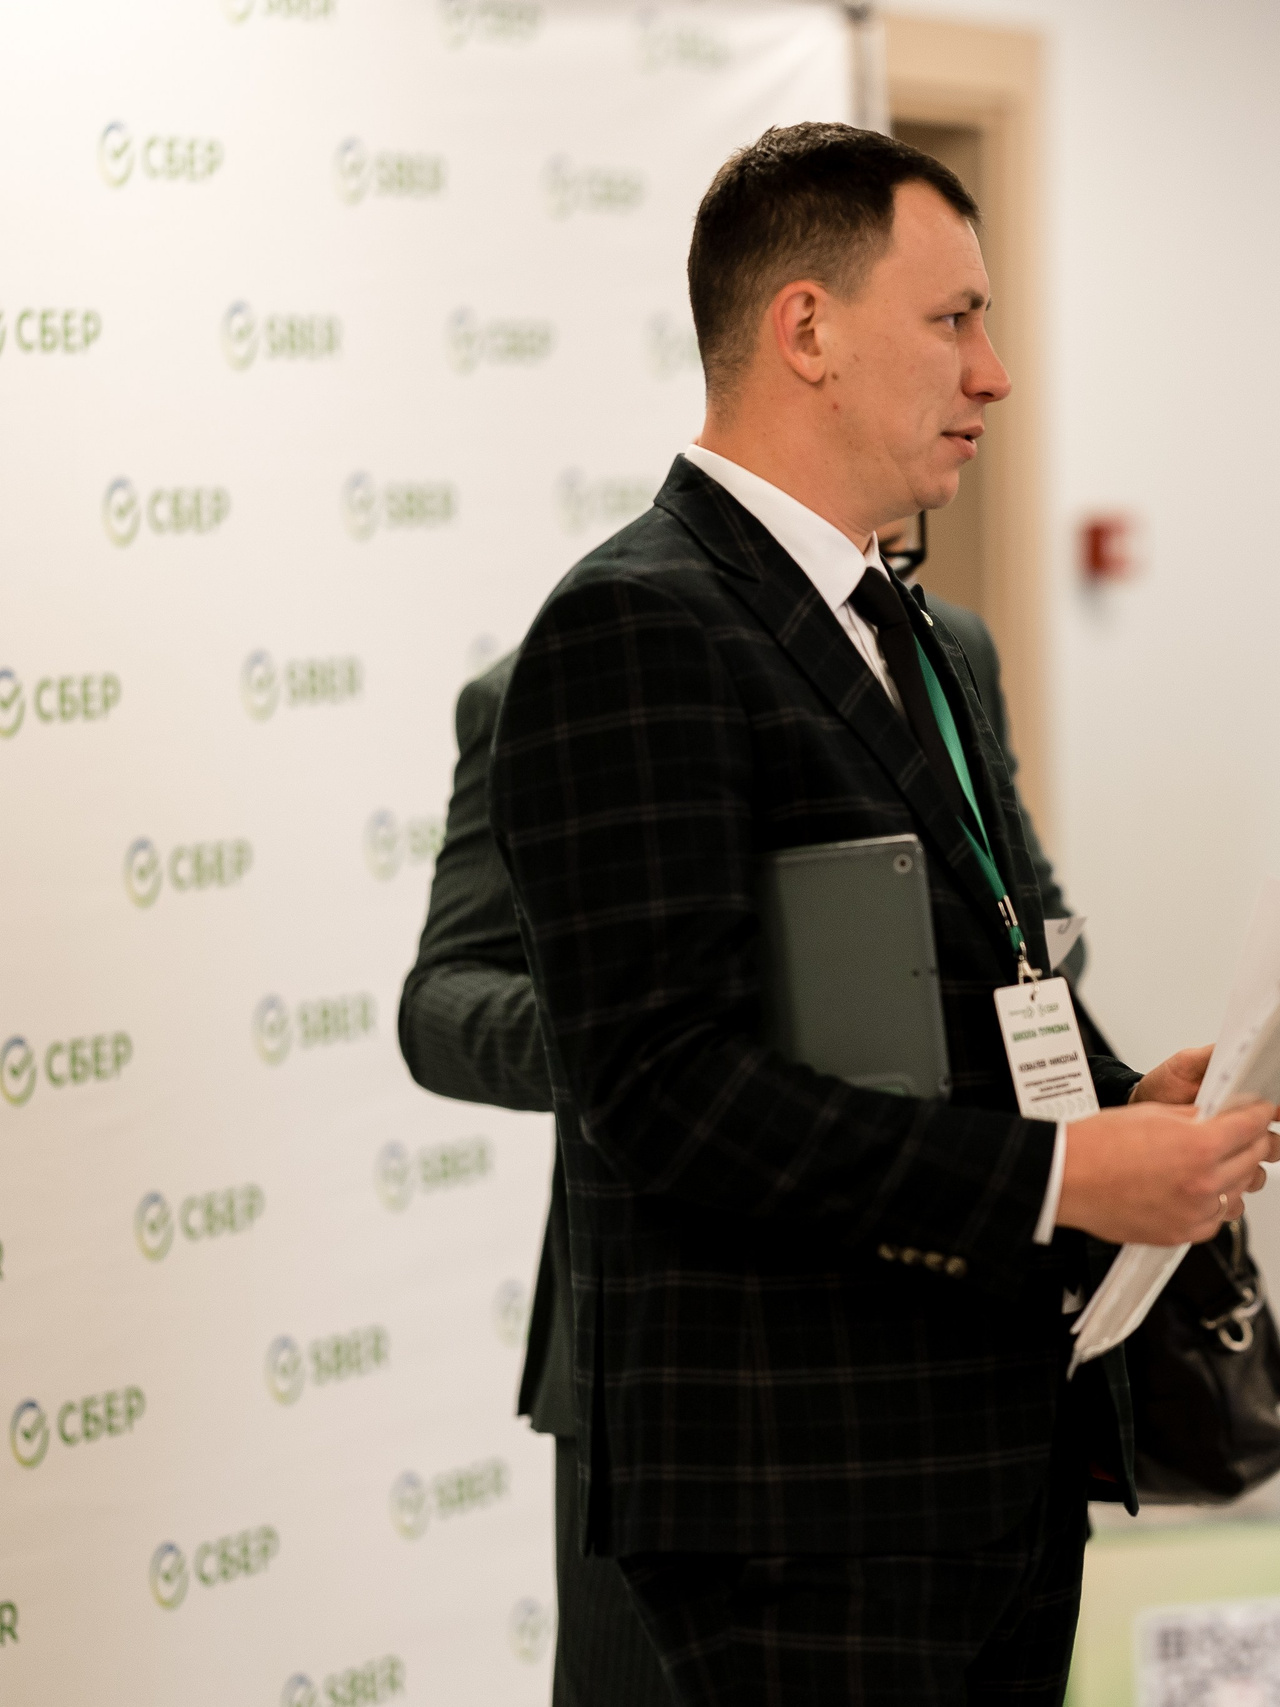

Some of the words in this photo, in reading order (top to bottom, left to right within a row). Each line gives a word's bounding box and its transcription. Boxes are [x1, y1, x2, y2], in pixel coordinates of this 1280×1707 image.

[141, 134, 225, 183] СБЕР
[15, 307, 103, 355] СБЕР
[147, 485, 232, 536] СБЕР
[33, 672, 122, 725] СБЕР
[168, 838, 254, 892] СБЕР
[44, 1031, 134, 1089] СБЕР
[179, 1183, 266, 1242] СБЕР
[57, 1386, 147, 1447] СБЕР
[194, 1525, 280, 1587] СБЕР
